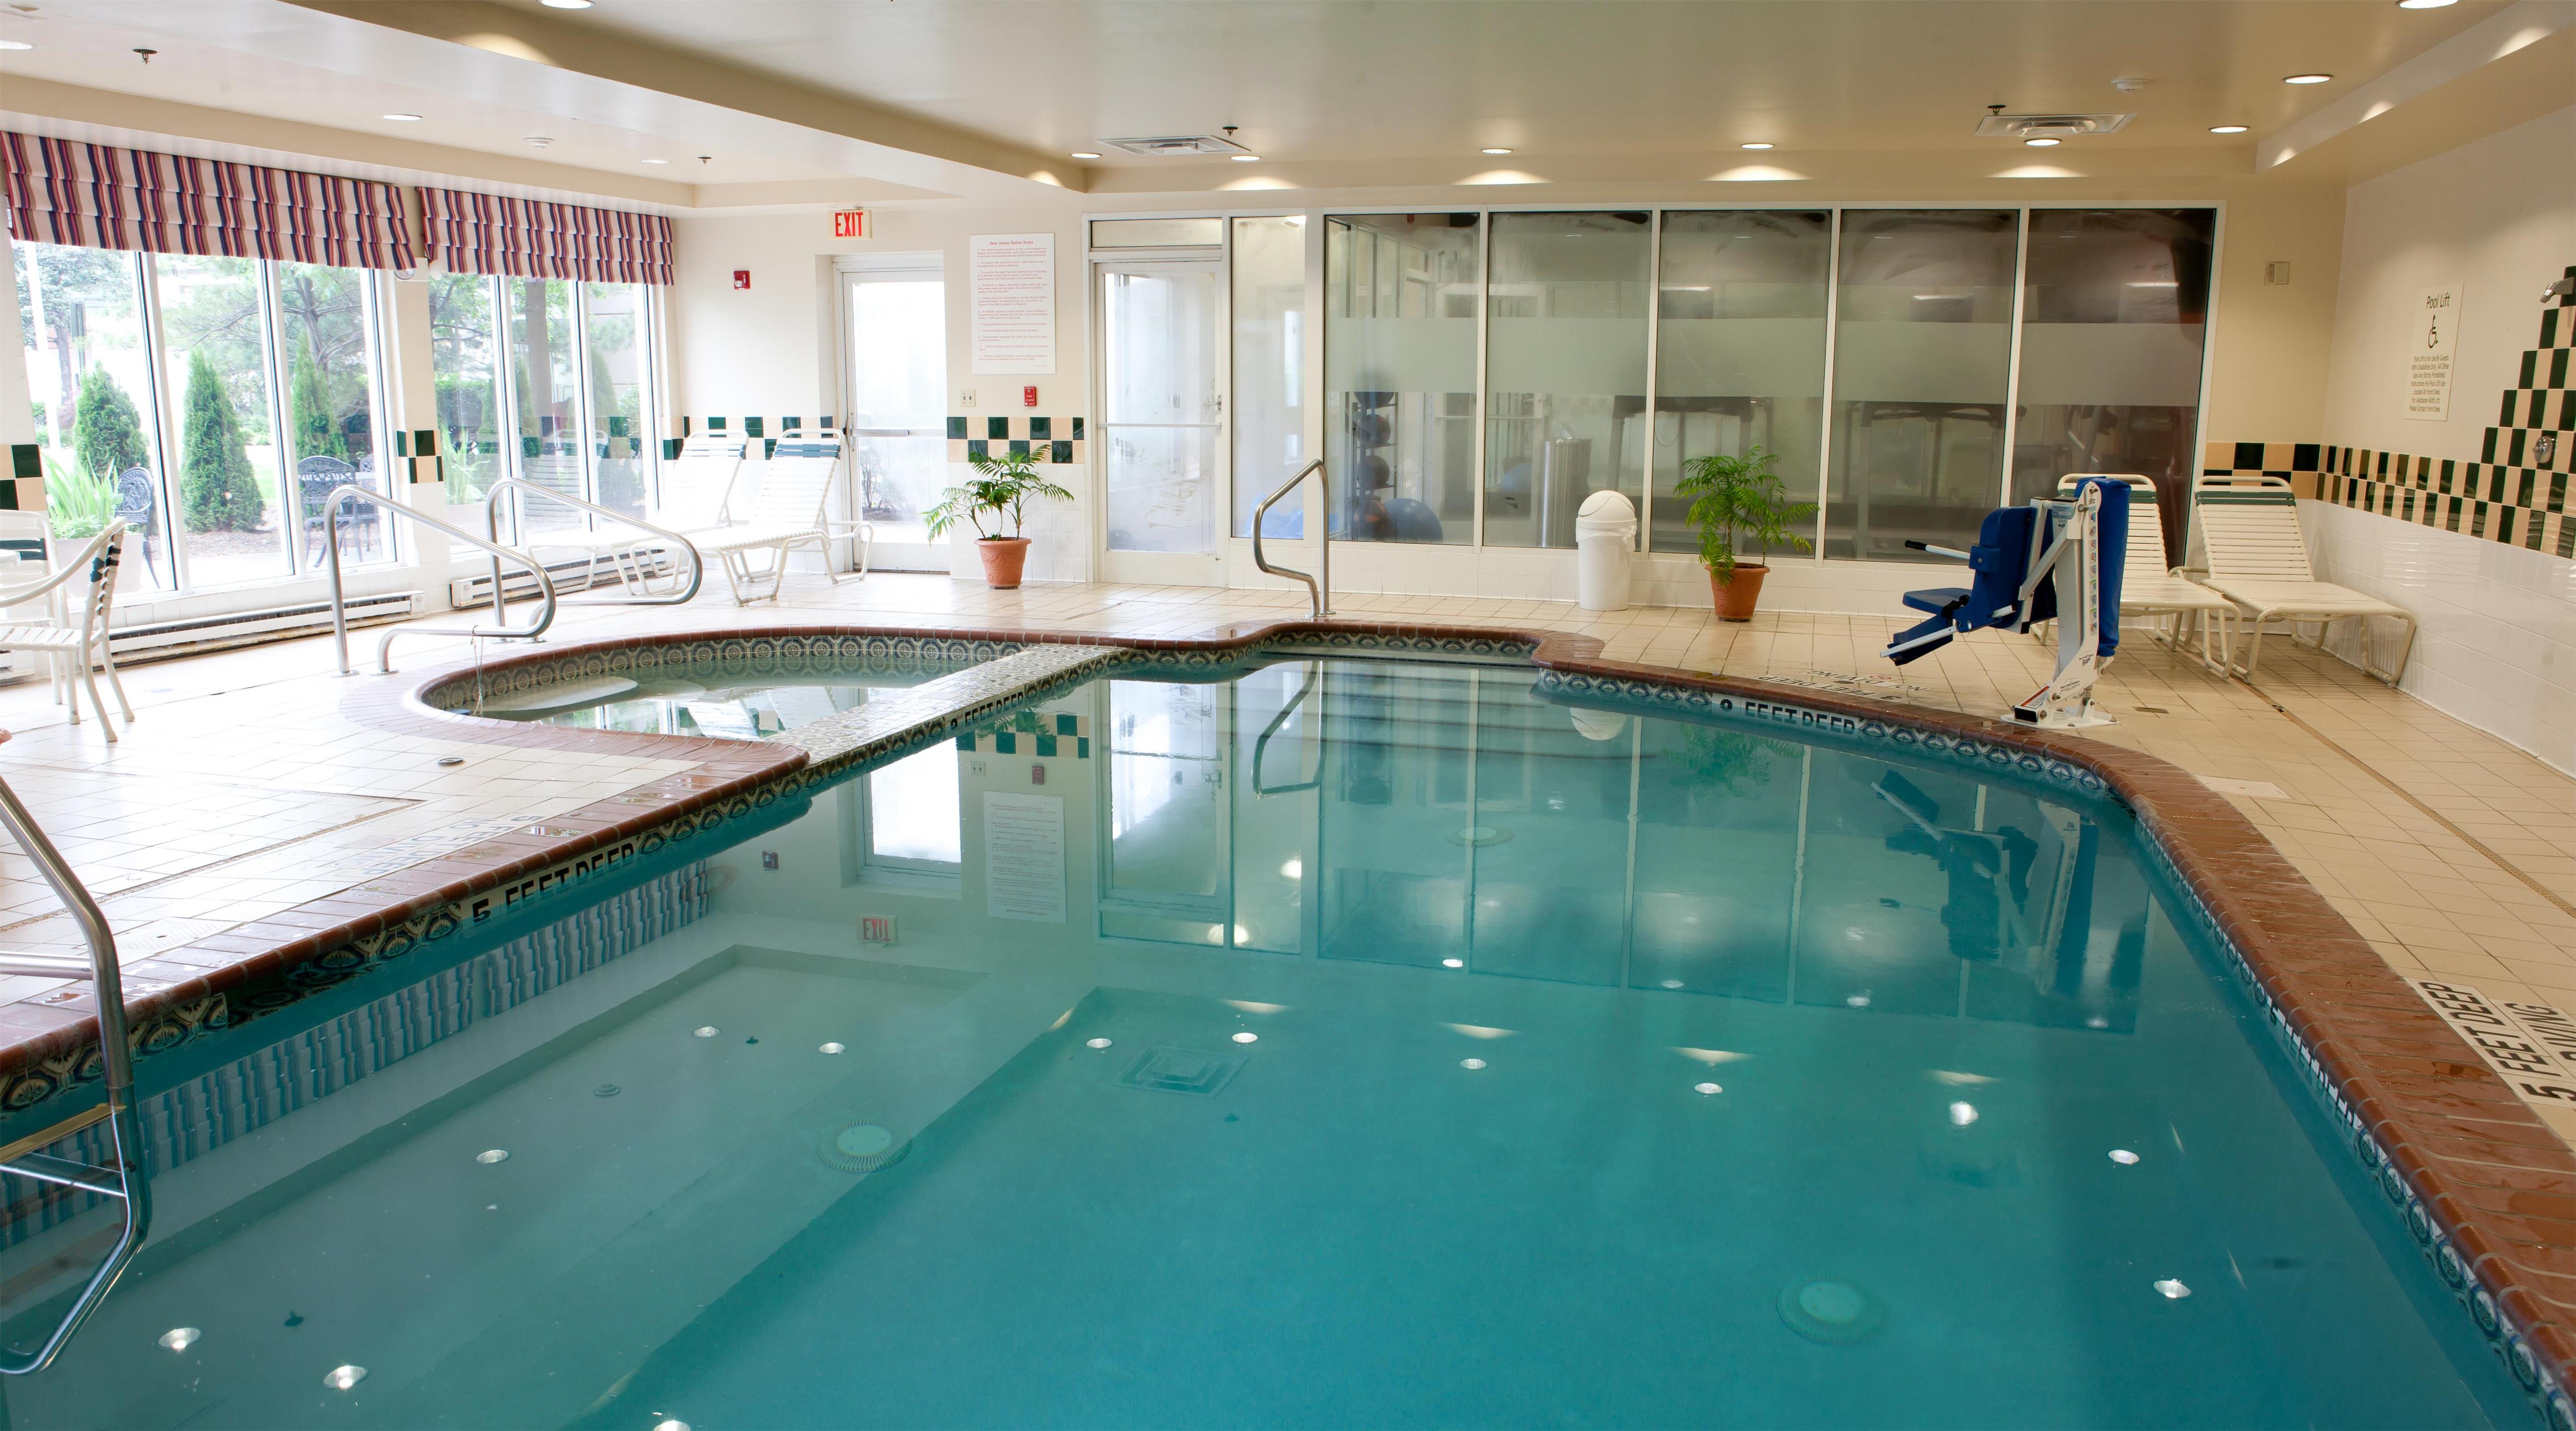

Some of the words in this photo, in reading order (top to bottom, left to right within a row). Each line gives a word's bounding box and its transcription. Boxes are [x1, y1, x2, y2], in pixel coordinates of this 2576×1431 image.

[835, 212, 863, 237] EXIT
[2426, 294, 2439, 309] Pool
[2440, 292, 2450, 307] Lift
[1758, 676, 1817, 687] DEEP
[1807, 671, 1885, 684] DIVING
[1817, 685, 1876, 696] FEET
[437, 826, 516, 848] FEET
[361, 851, 443, 874] DEEP
[472, 898, 491, 923] 5
[2418, 982, 2506, 1026] DEEP
[2463, 1026, 2562, 1077] FEET
[2518, 1083, 2576, 1102] 5
